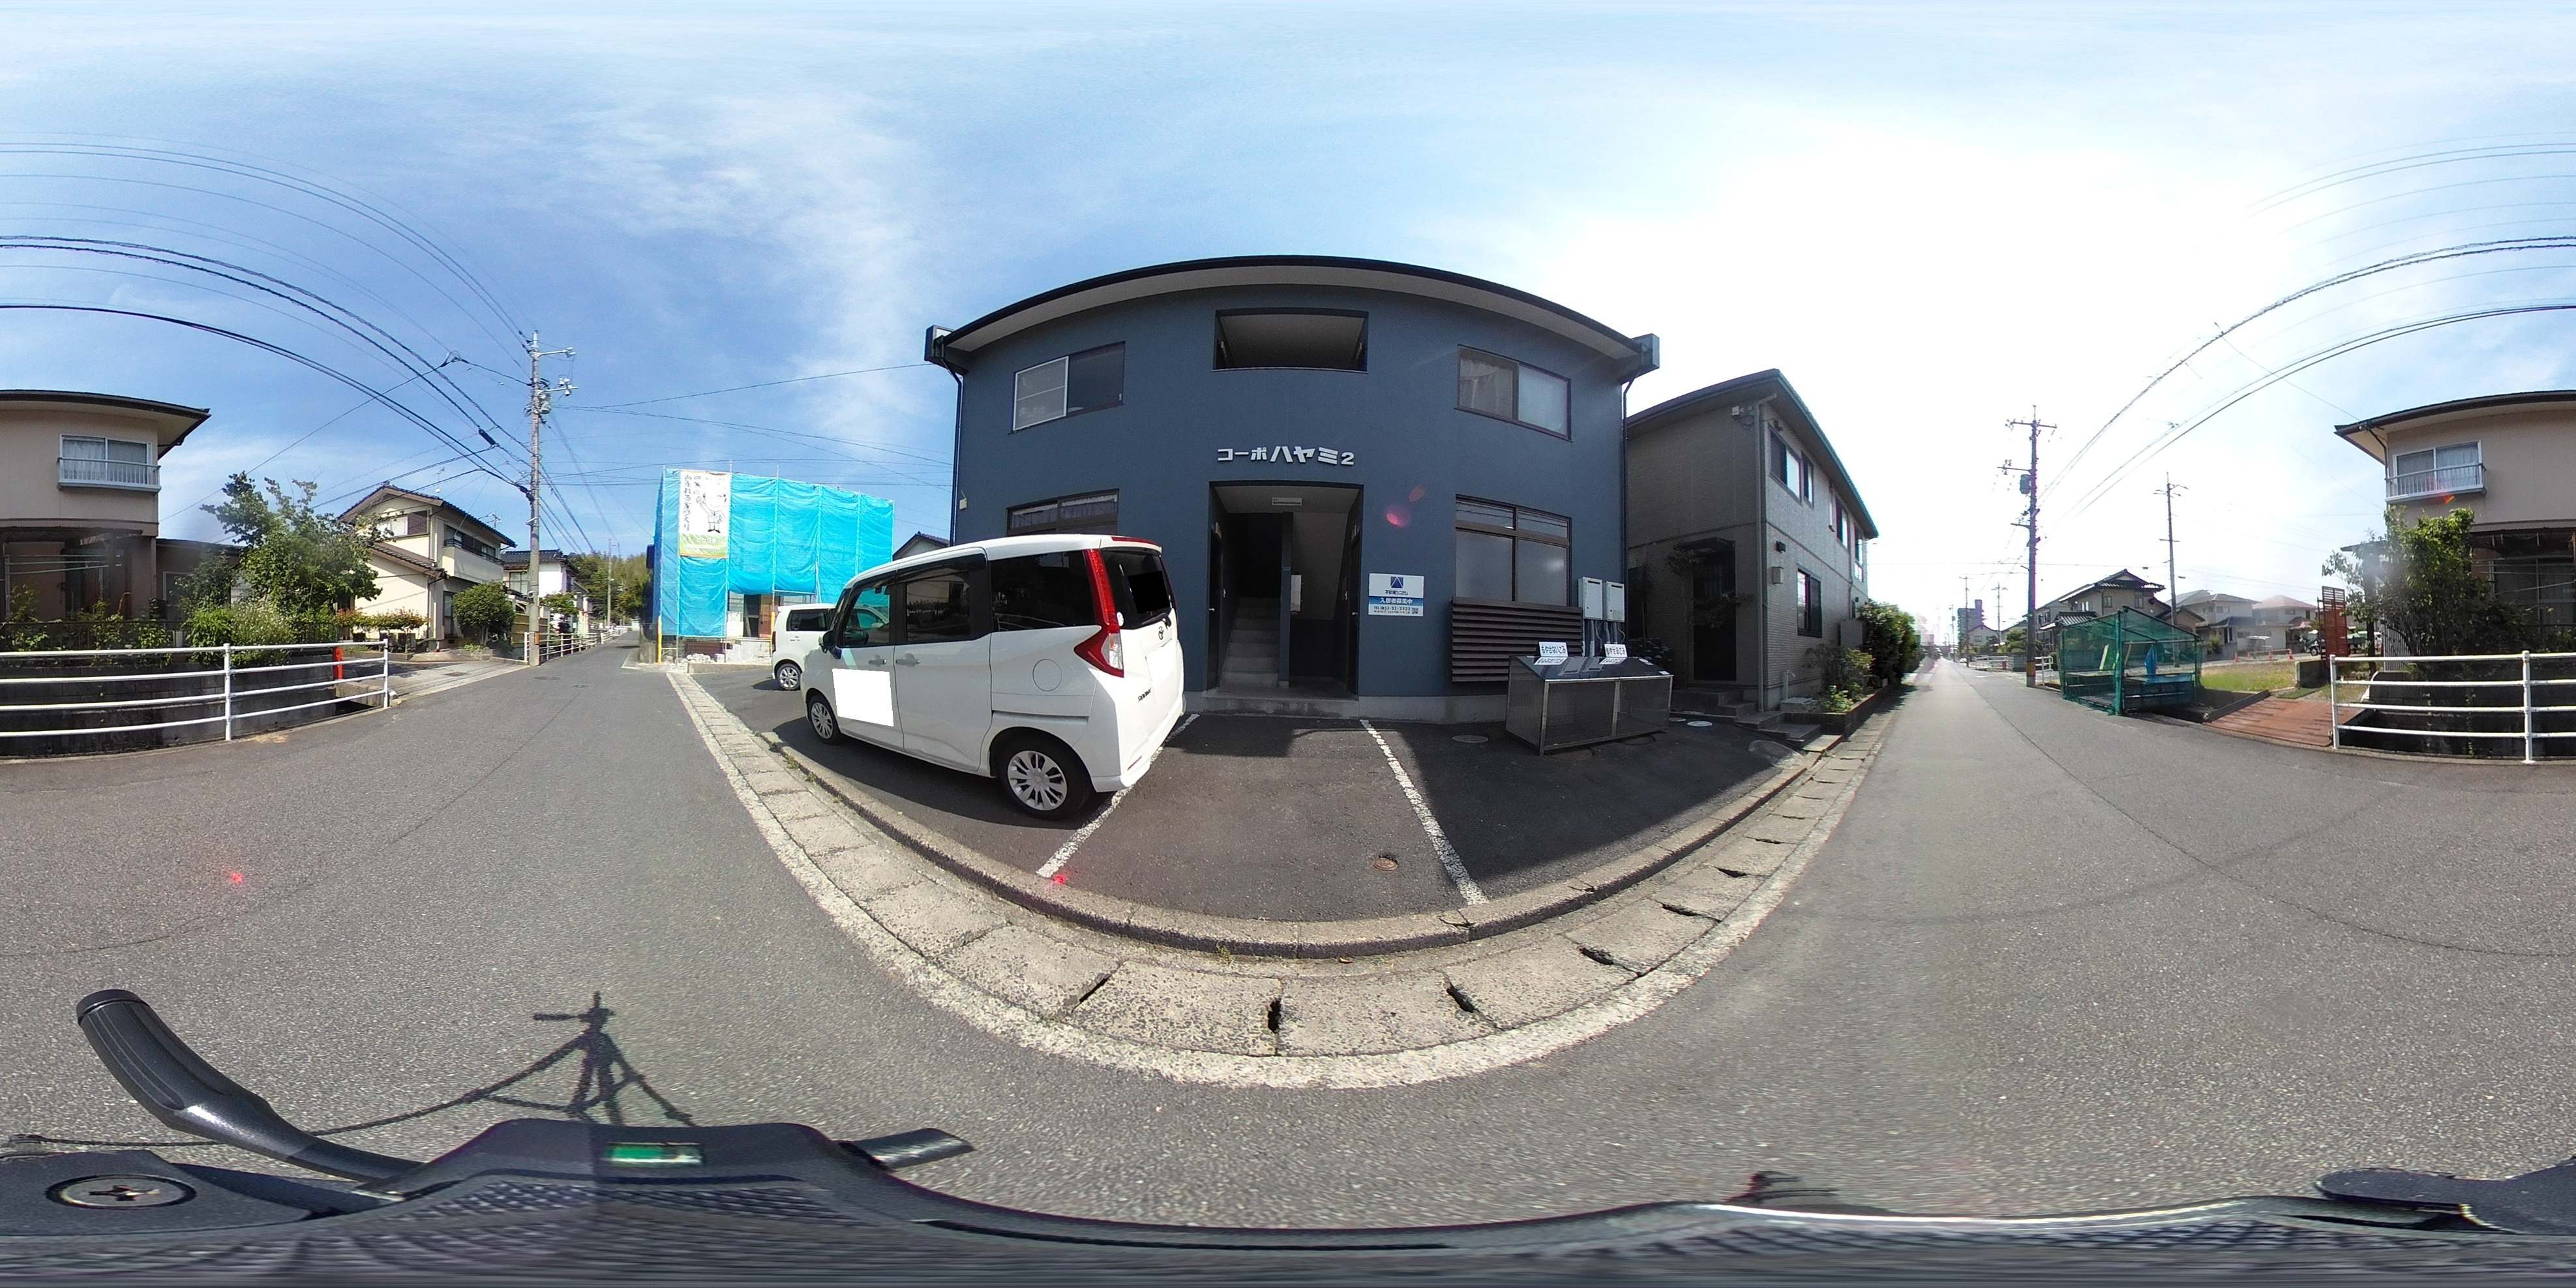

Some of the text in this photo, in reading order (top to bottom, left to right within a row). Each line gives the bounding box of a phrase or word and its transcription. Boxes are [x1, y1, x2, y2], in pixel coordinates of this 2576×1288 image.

[1217, 445, 1355, 465] コーポハヤミ2
